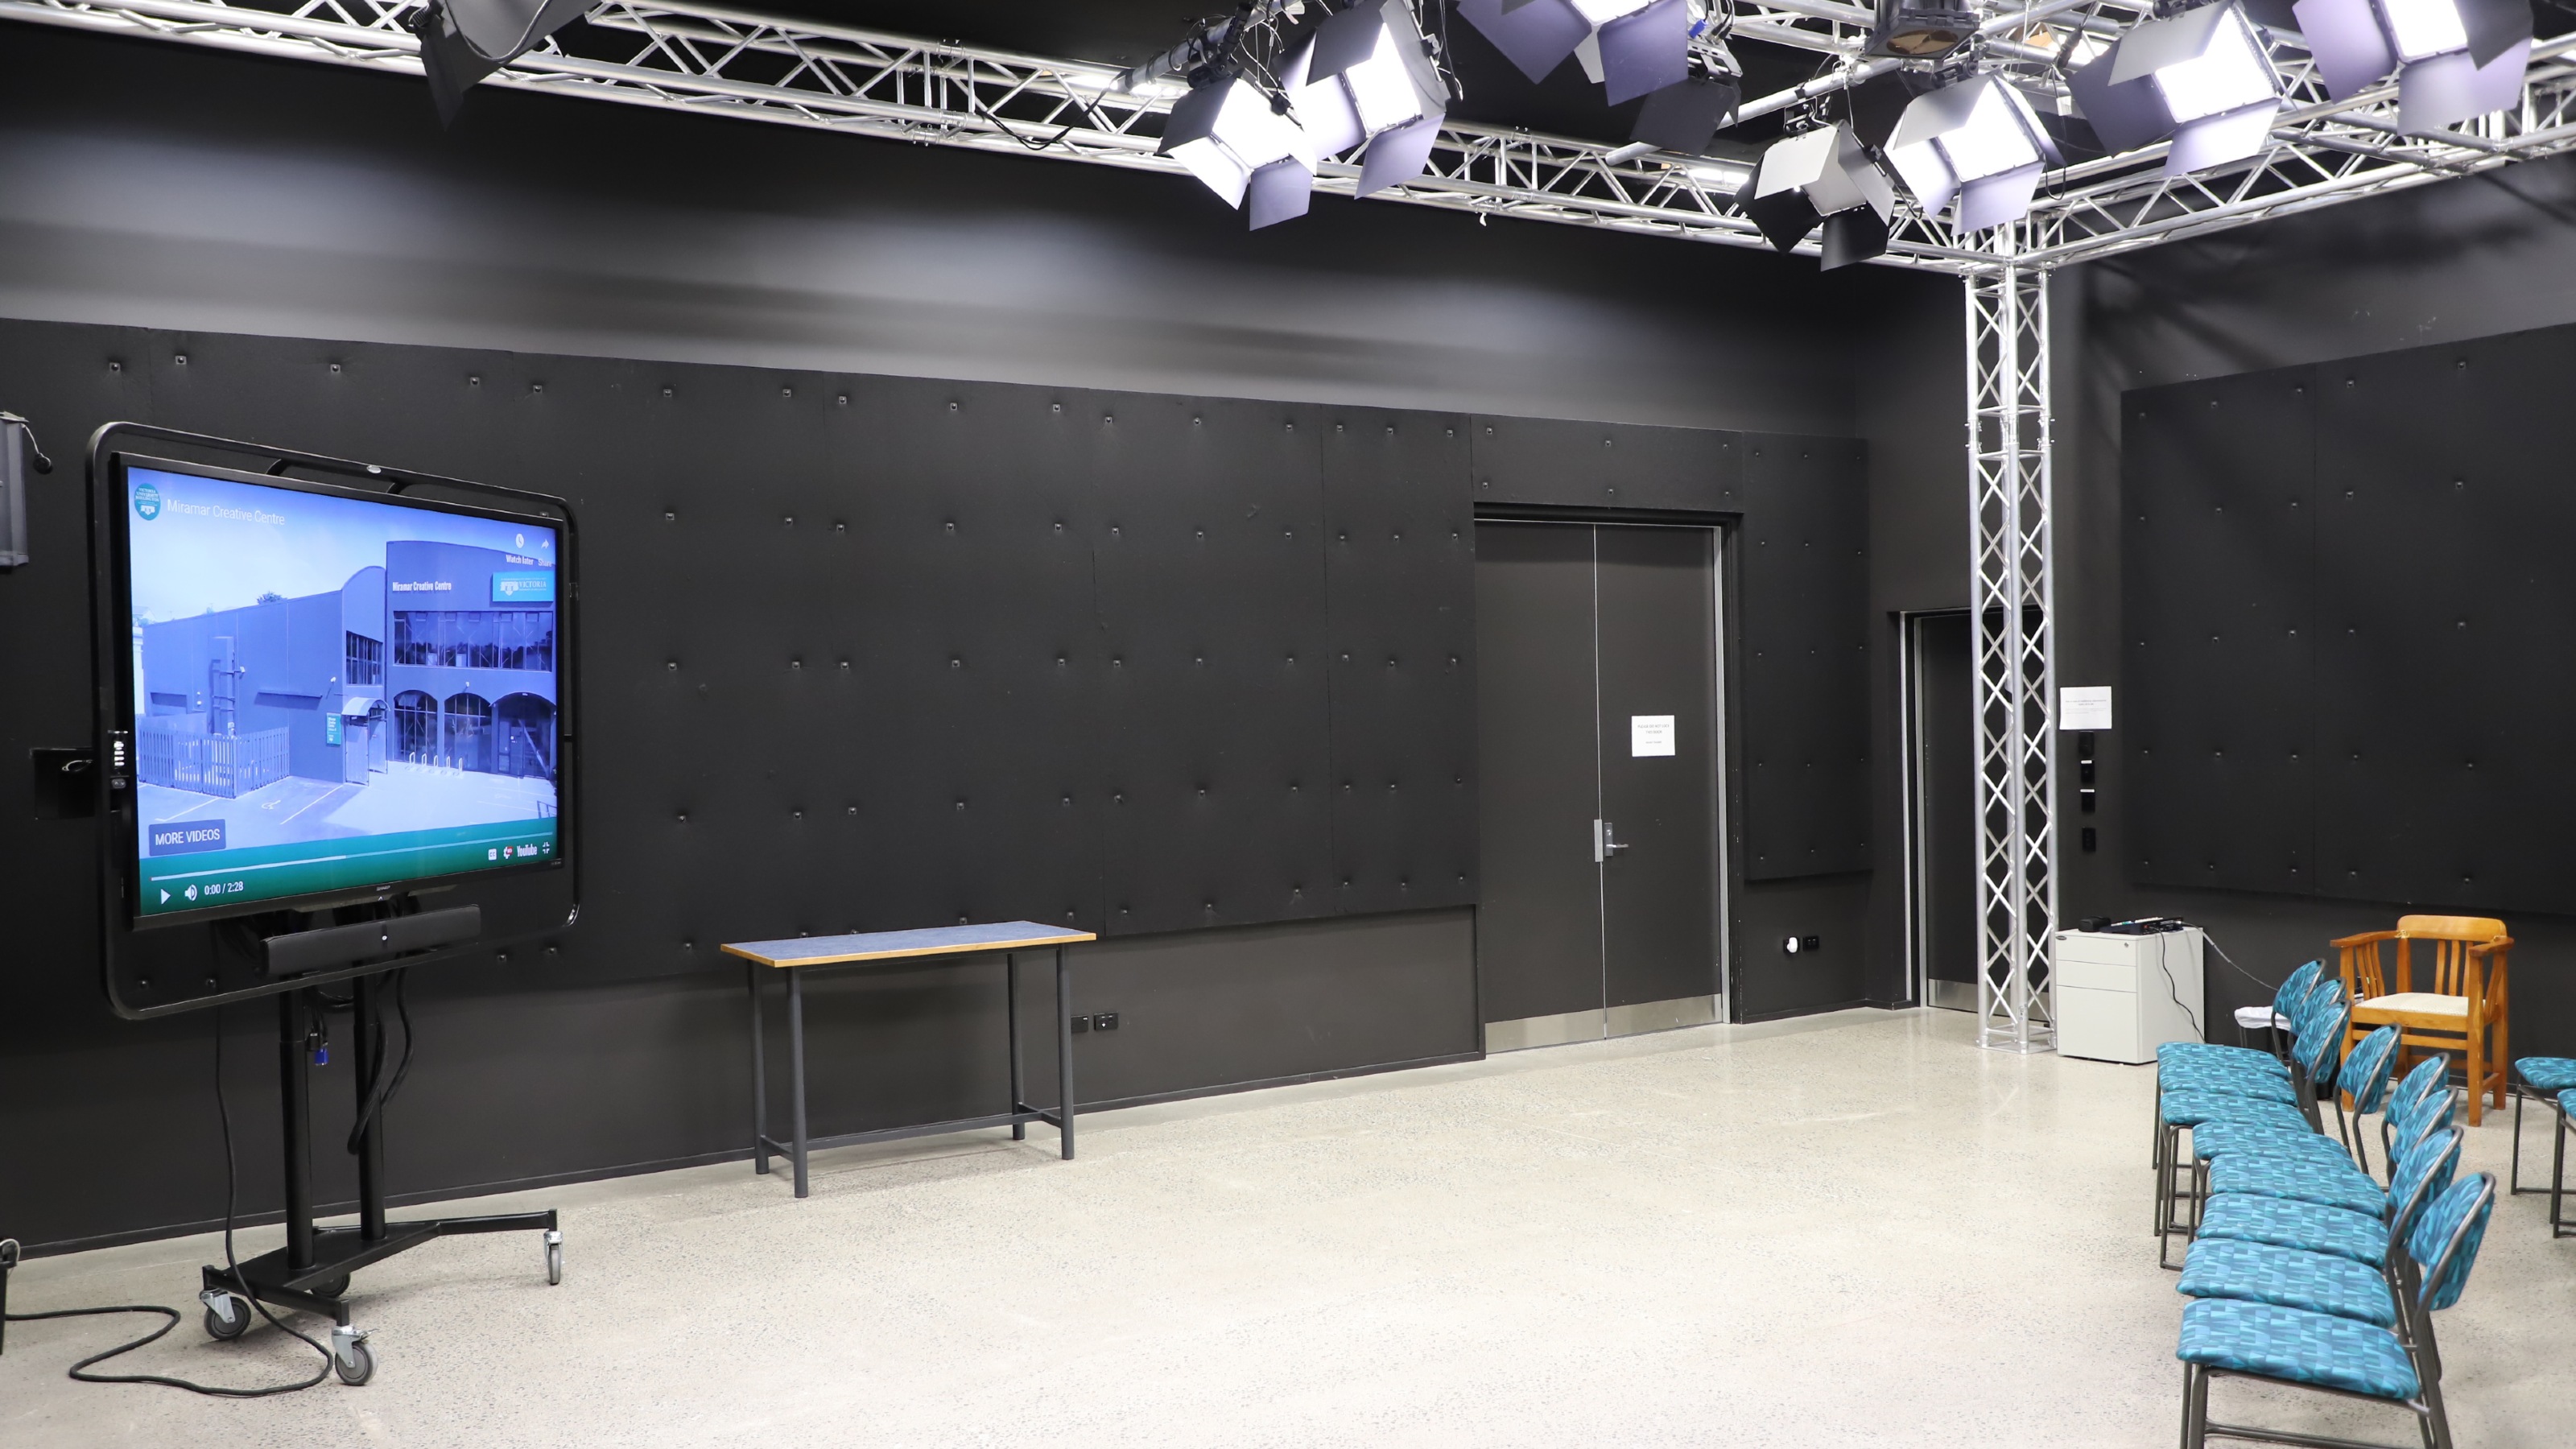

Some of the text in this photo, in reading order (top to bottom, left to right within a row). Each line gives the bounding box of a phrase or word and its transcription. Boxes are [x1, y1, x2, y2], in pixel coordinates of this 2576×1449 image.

[167, 498, 285, 526] Miramar Creative Centre
[506, 554, 534, 565] Watch later
[538, 558, 552, 568] Share
[393, 580, 452, 591] Miramar Creative Centre
[518, 580, 547, 588] VICTORIA
[155, 828, 221, 845] MORE VIDEOS
[517, 844, 538, 857] YouTube
[204, 881, 244, 895] 0:00 / 2:28
